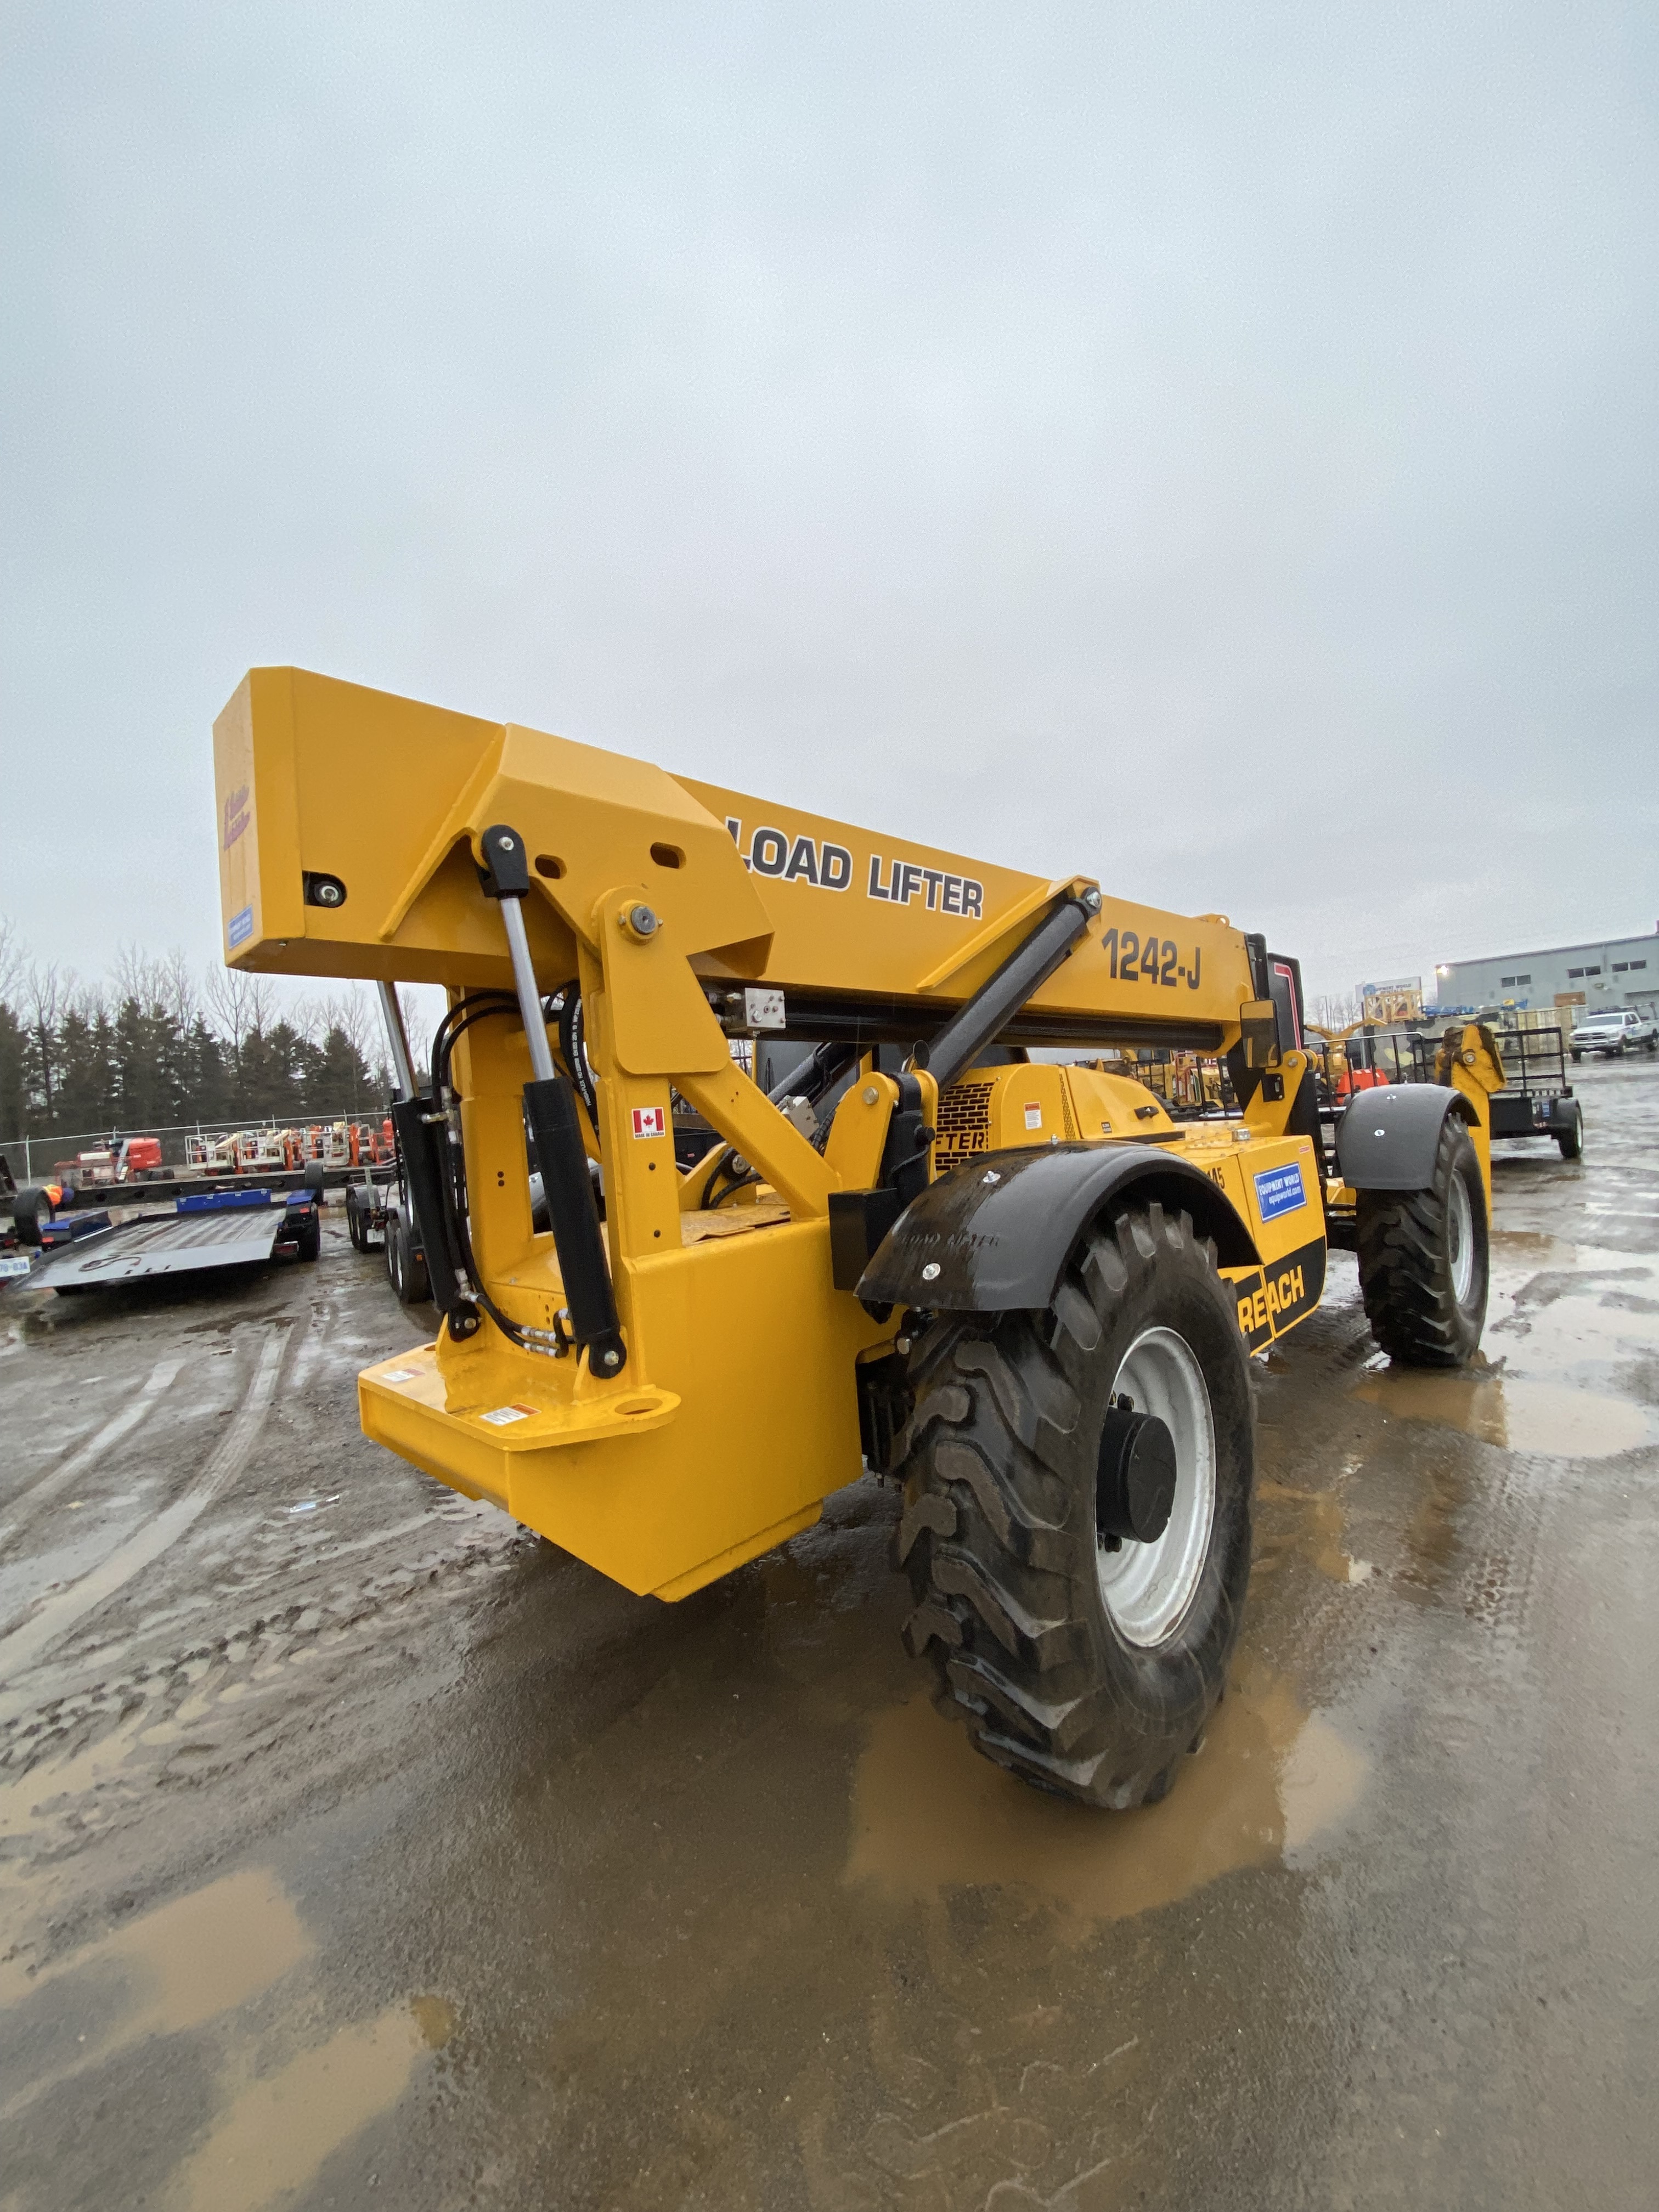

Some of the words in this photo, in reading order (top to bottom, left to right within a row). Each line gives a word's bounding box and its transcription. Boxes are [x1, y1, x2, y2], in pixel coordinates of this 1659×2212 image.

[867, 854, 984, 920] LIFTER
[1102, 928, 1201, 990] 1242-J
[1259, 1178, 1283, 1195] EQUIPMENT
[1283, 1173, 1300, 1187] WORLD
[1268, 1186, 1301, 1205] equipworld.com
[1237, 1265, 1305, 1333] REACH
